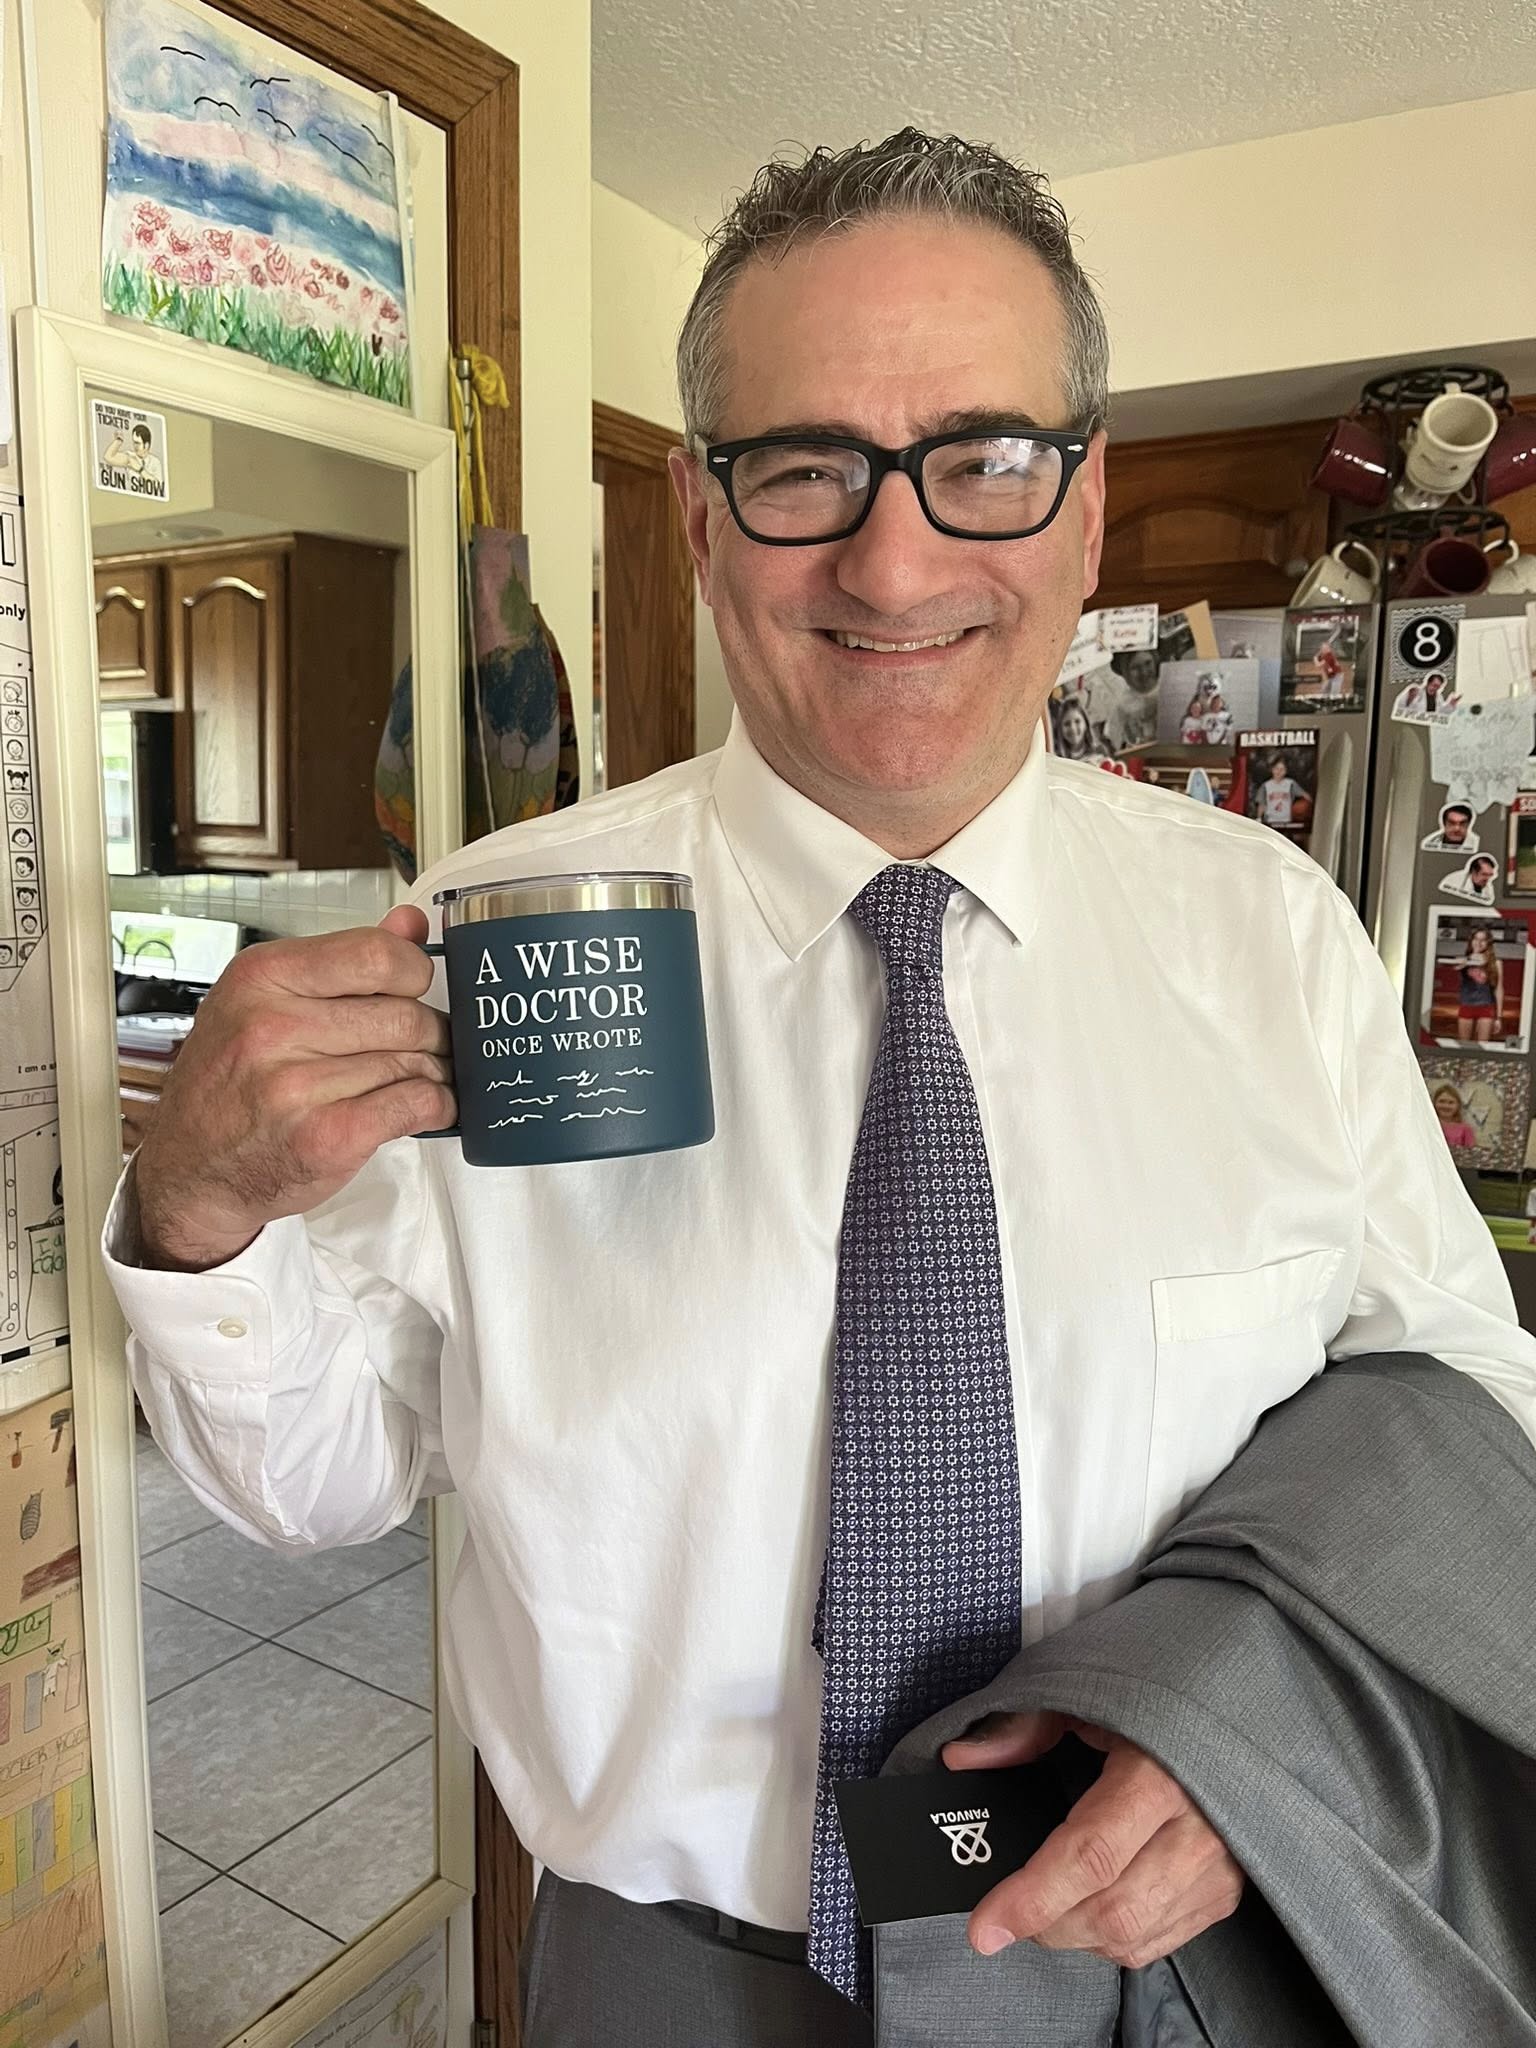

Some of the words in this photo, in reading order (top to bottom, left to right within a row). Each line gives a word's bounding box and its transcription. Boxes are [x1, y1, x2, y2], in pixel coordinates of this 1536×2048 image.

[98, 413, 130, 431] TICKETS
[101, 469, 126, 491] GUN
[131, 476, 165, 498] SHOW
[1413, 622, 1441, 662] 8
[1240, 730, 1315, 748] BASKETBALL
[475, 948, 502, 985] A
[515, 936, 643, 980] WISE
[475, 983, 648, 1029] DOCTOR
[482, 1035, 543, 1058] ONCE
[551, 1027, 642, 1052] WROTE
[25, 1065, 38, 1073] am
[929, 1807, 990, 1825] PANVOLA
